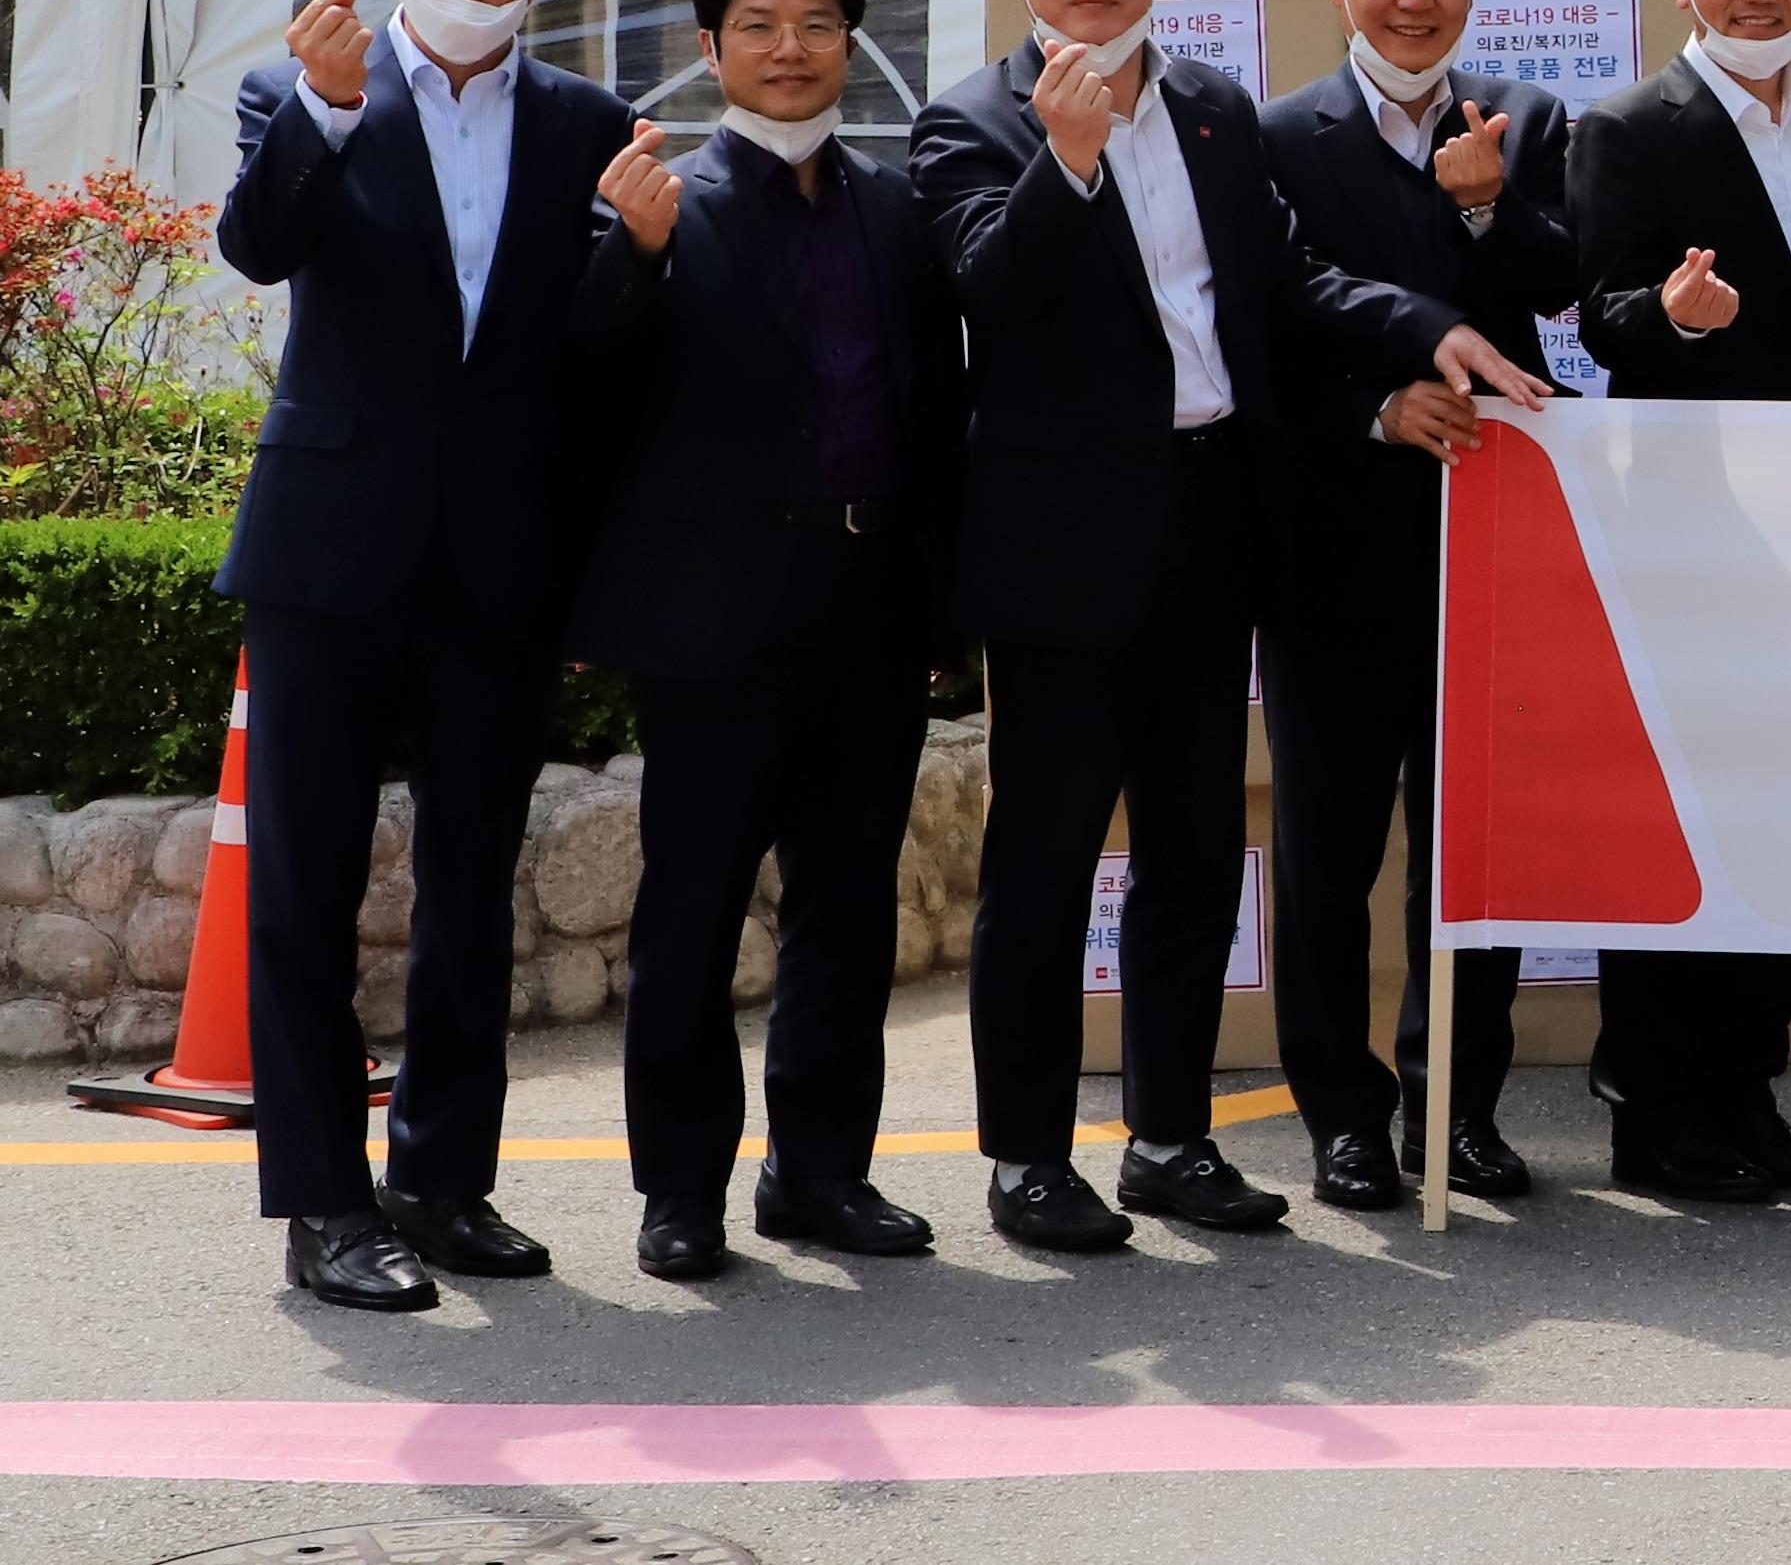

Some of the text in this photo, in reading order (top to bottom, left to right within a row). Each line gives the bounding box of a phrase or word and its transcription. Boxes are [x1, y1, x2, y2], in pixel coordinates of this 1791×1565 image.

[1188, 14, 1223, 33] 대응
[1476, 4, 1598, 26] 코로나19 대응
[1476, 33, 1600, 52] 의료진/복지기관
[1516, 58, 1561, 80] 물품
[1574, 55, 1618, 78] 전달
